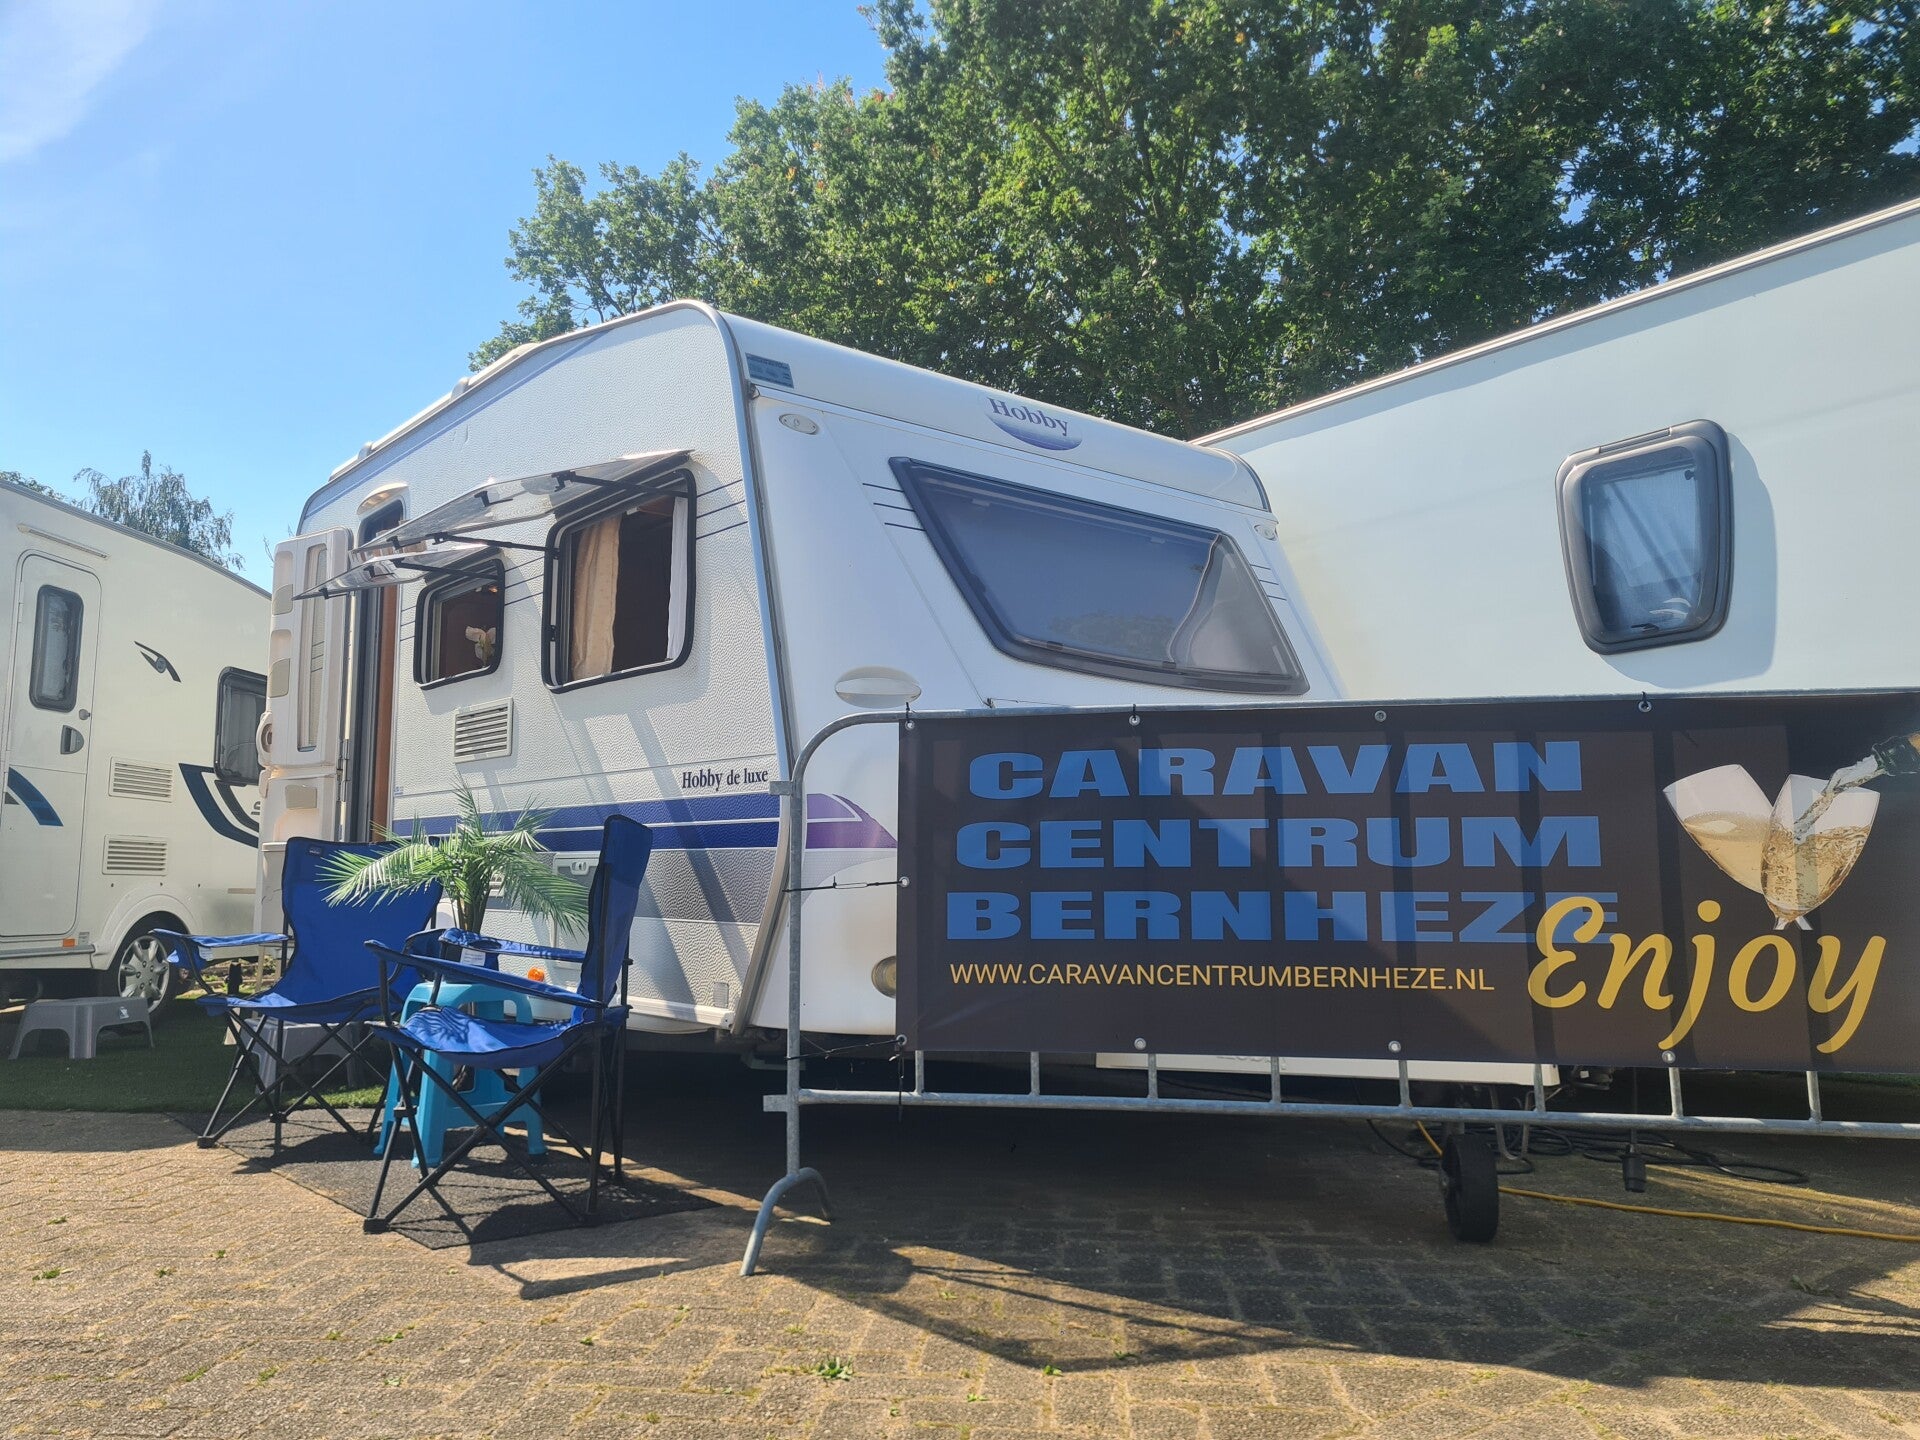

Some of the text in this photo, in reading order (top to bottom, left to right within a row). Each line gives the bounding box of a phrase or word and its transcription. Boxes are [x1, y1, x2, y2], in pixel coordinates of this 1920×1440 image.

[986, 396, 1068, 437] Hobby
[682, 768, 768, 791] Hobby de luxe
[970, 741, 1582, 799] CARAVAN
[956, 816, 1601, 869] CENTRUM
[947, 891, 1618, 943] BERNHEZE
[950, 963, 1495, 991] WWW.CARAVANCENTRUMBERNHEZE.NL
[1527, 896, 1886, 1053] Enjoy
